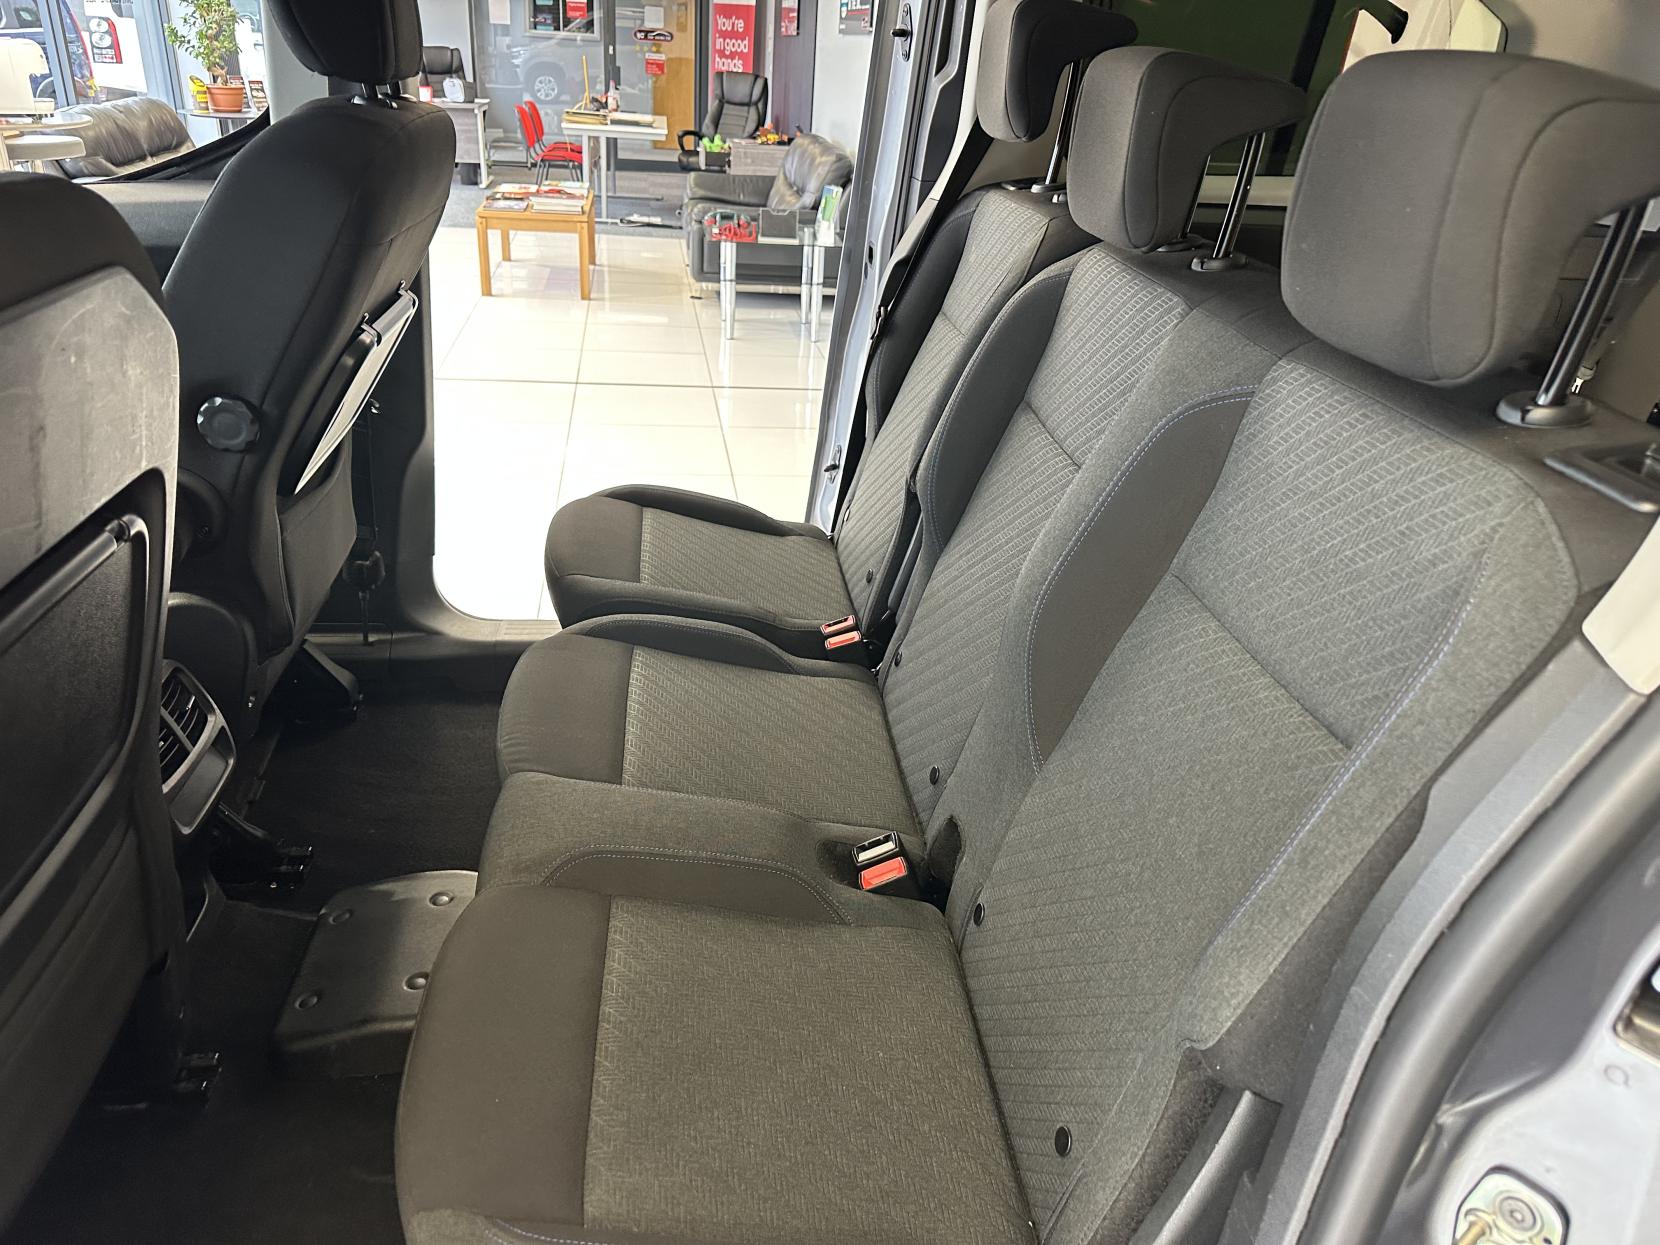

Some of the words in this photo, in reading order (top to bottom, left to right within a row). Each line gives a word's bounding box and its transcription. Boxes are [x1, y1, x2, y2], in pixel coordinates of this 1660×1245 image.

[715, 33, 724, 50] in
[724, 36, 749, 55] good
[715, 53, 743, 72] hands
